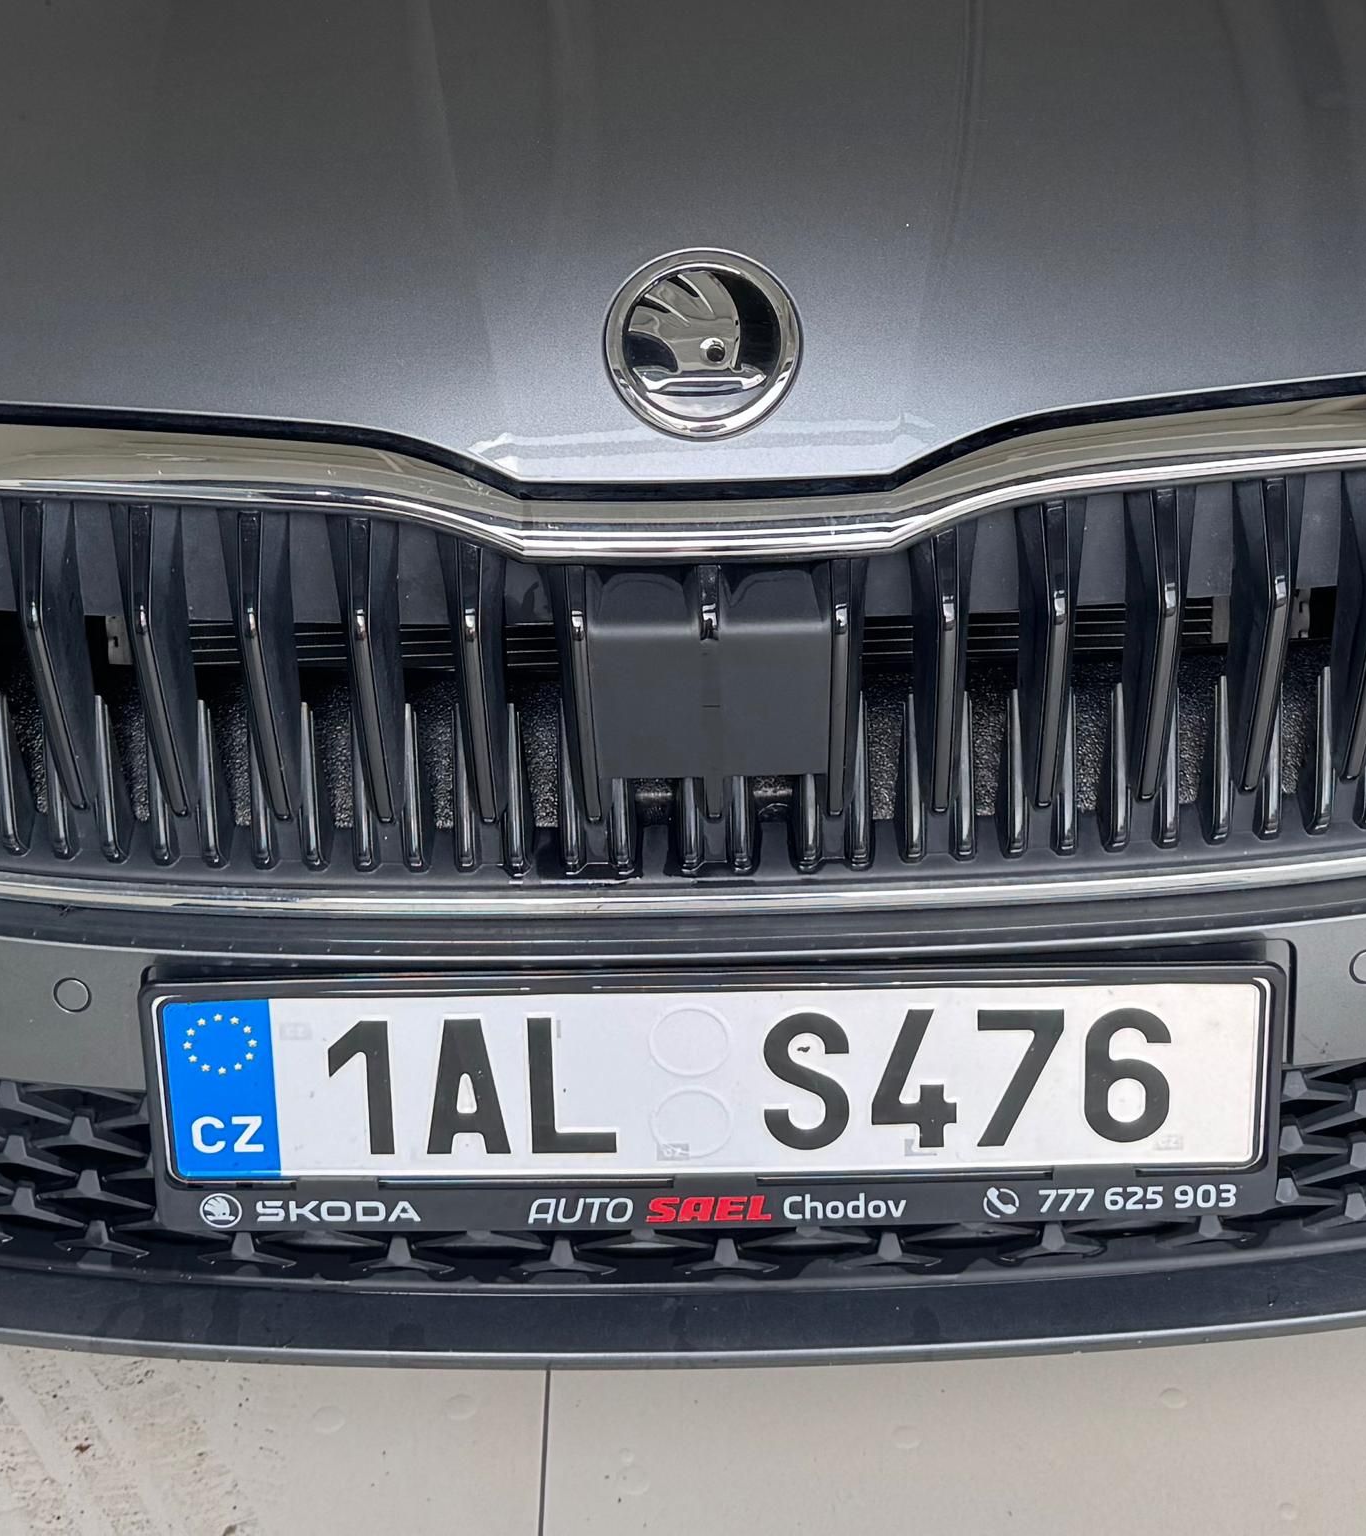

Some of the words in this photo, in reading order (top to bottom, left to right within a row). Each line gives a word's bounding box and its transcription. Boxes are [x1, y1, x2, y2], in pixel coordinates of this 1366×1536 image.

[327, 1016, 617, 1155] 1AL
[763, 1007, 1172, 1151] S476
[191, 1115, 265, 1154] CZ
[527, 1197, 634, 1224] AUTO
[645, 1195, 773, 1224] SAEL
[782, 1192, 908, 1221] Chodov
[1037, 1187, 1095, 1214] 777
[1103, 1185, 1164, 1211] 625
[1173, 1182, 1238, 1209] 903
